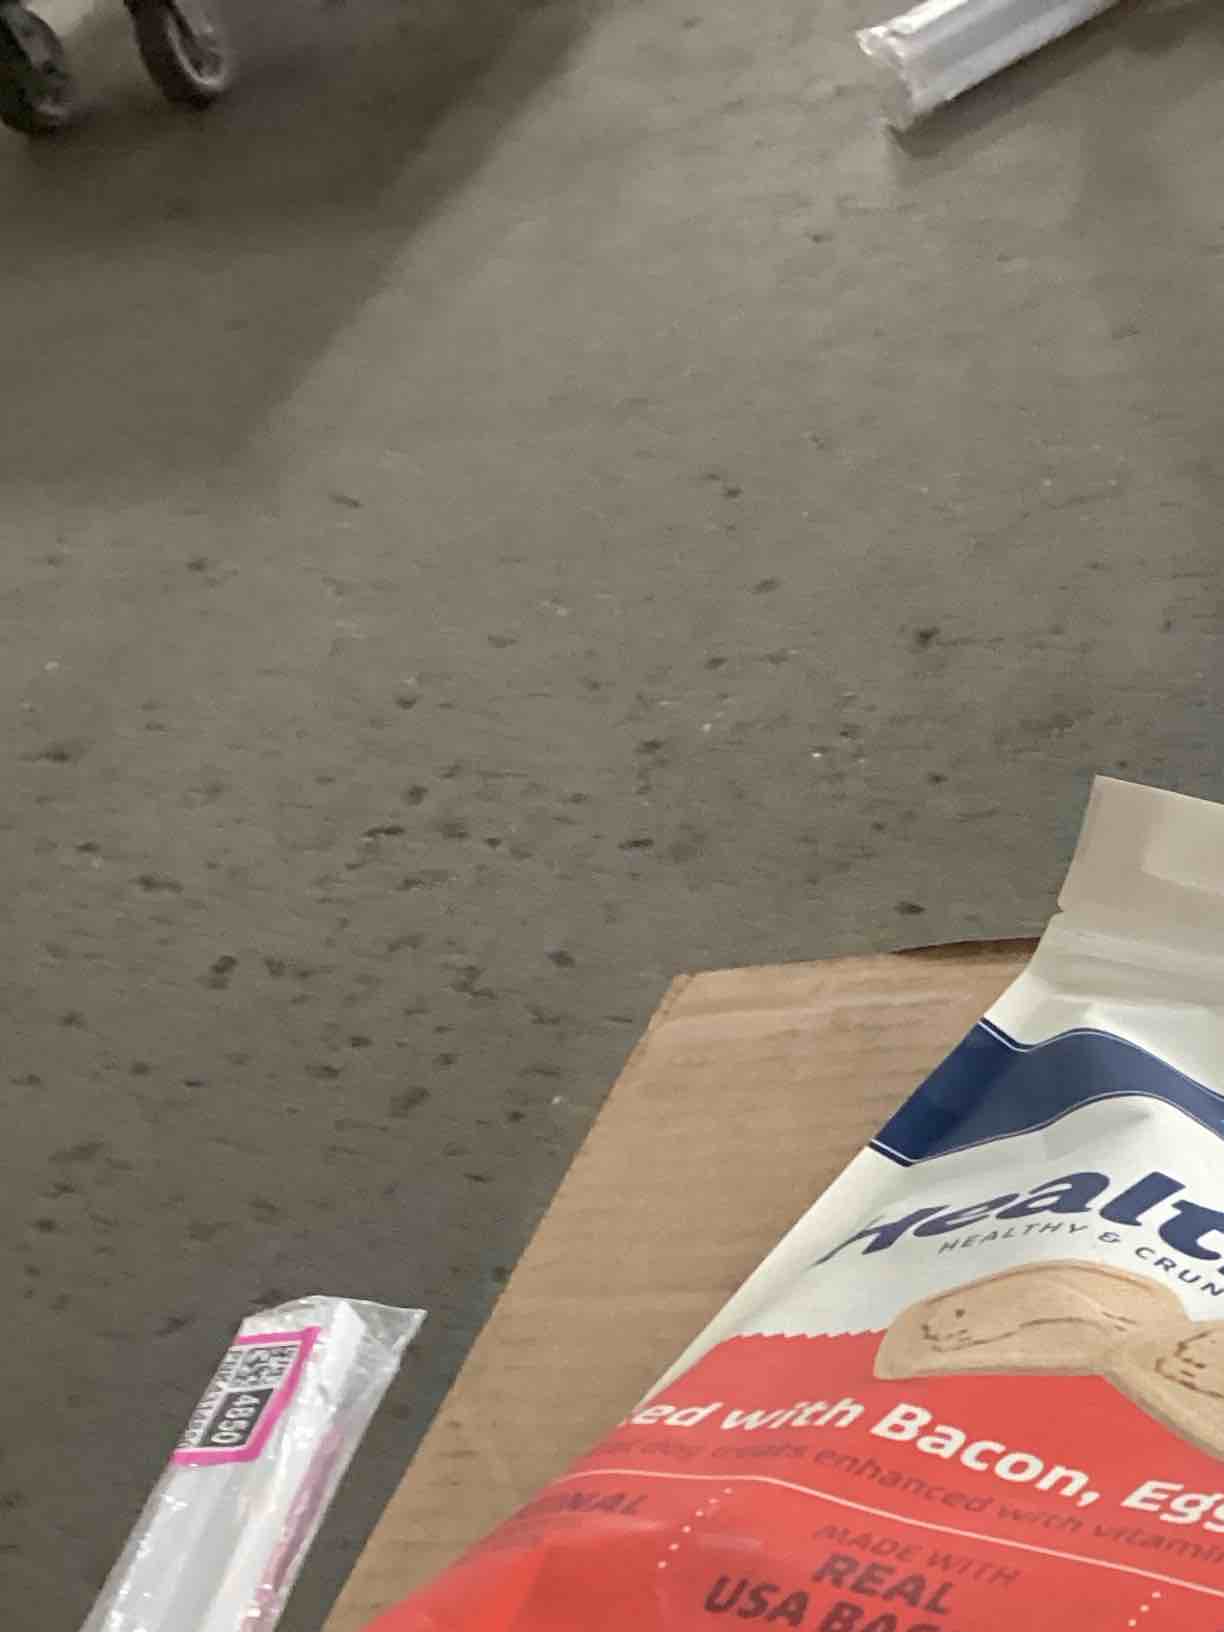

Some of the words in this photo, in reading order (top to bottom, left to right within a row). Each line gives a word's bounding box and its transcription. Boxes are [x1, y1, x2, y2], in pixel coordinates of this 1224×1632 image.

[936, 1220, 1090, 1255] HEALTHY
[1098, 1230, 1122, 1245] &
[209, 1394, 262, 1445] 4850
[720, 1397, 866, 1431] with
[869, 1402, 1101, 1507] Bacon,
[812, 1445, 995, 1515] enhanced
[996, 1502, 1084, 1535] with
[811, 1552, 958, 1616] REAL
[814, 1525, 917, 1562] MADE
[927, 1549, 1023, 1587] WITH
[703, 1574, 811, 1629] USA
